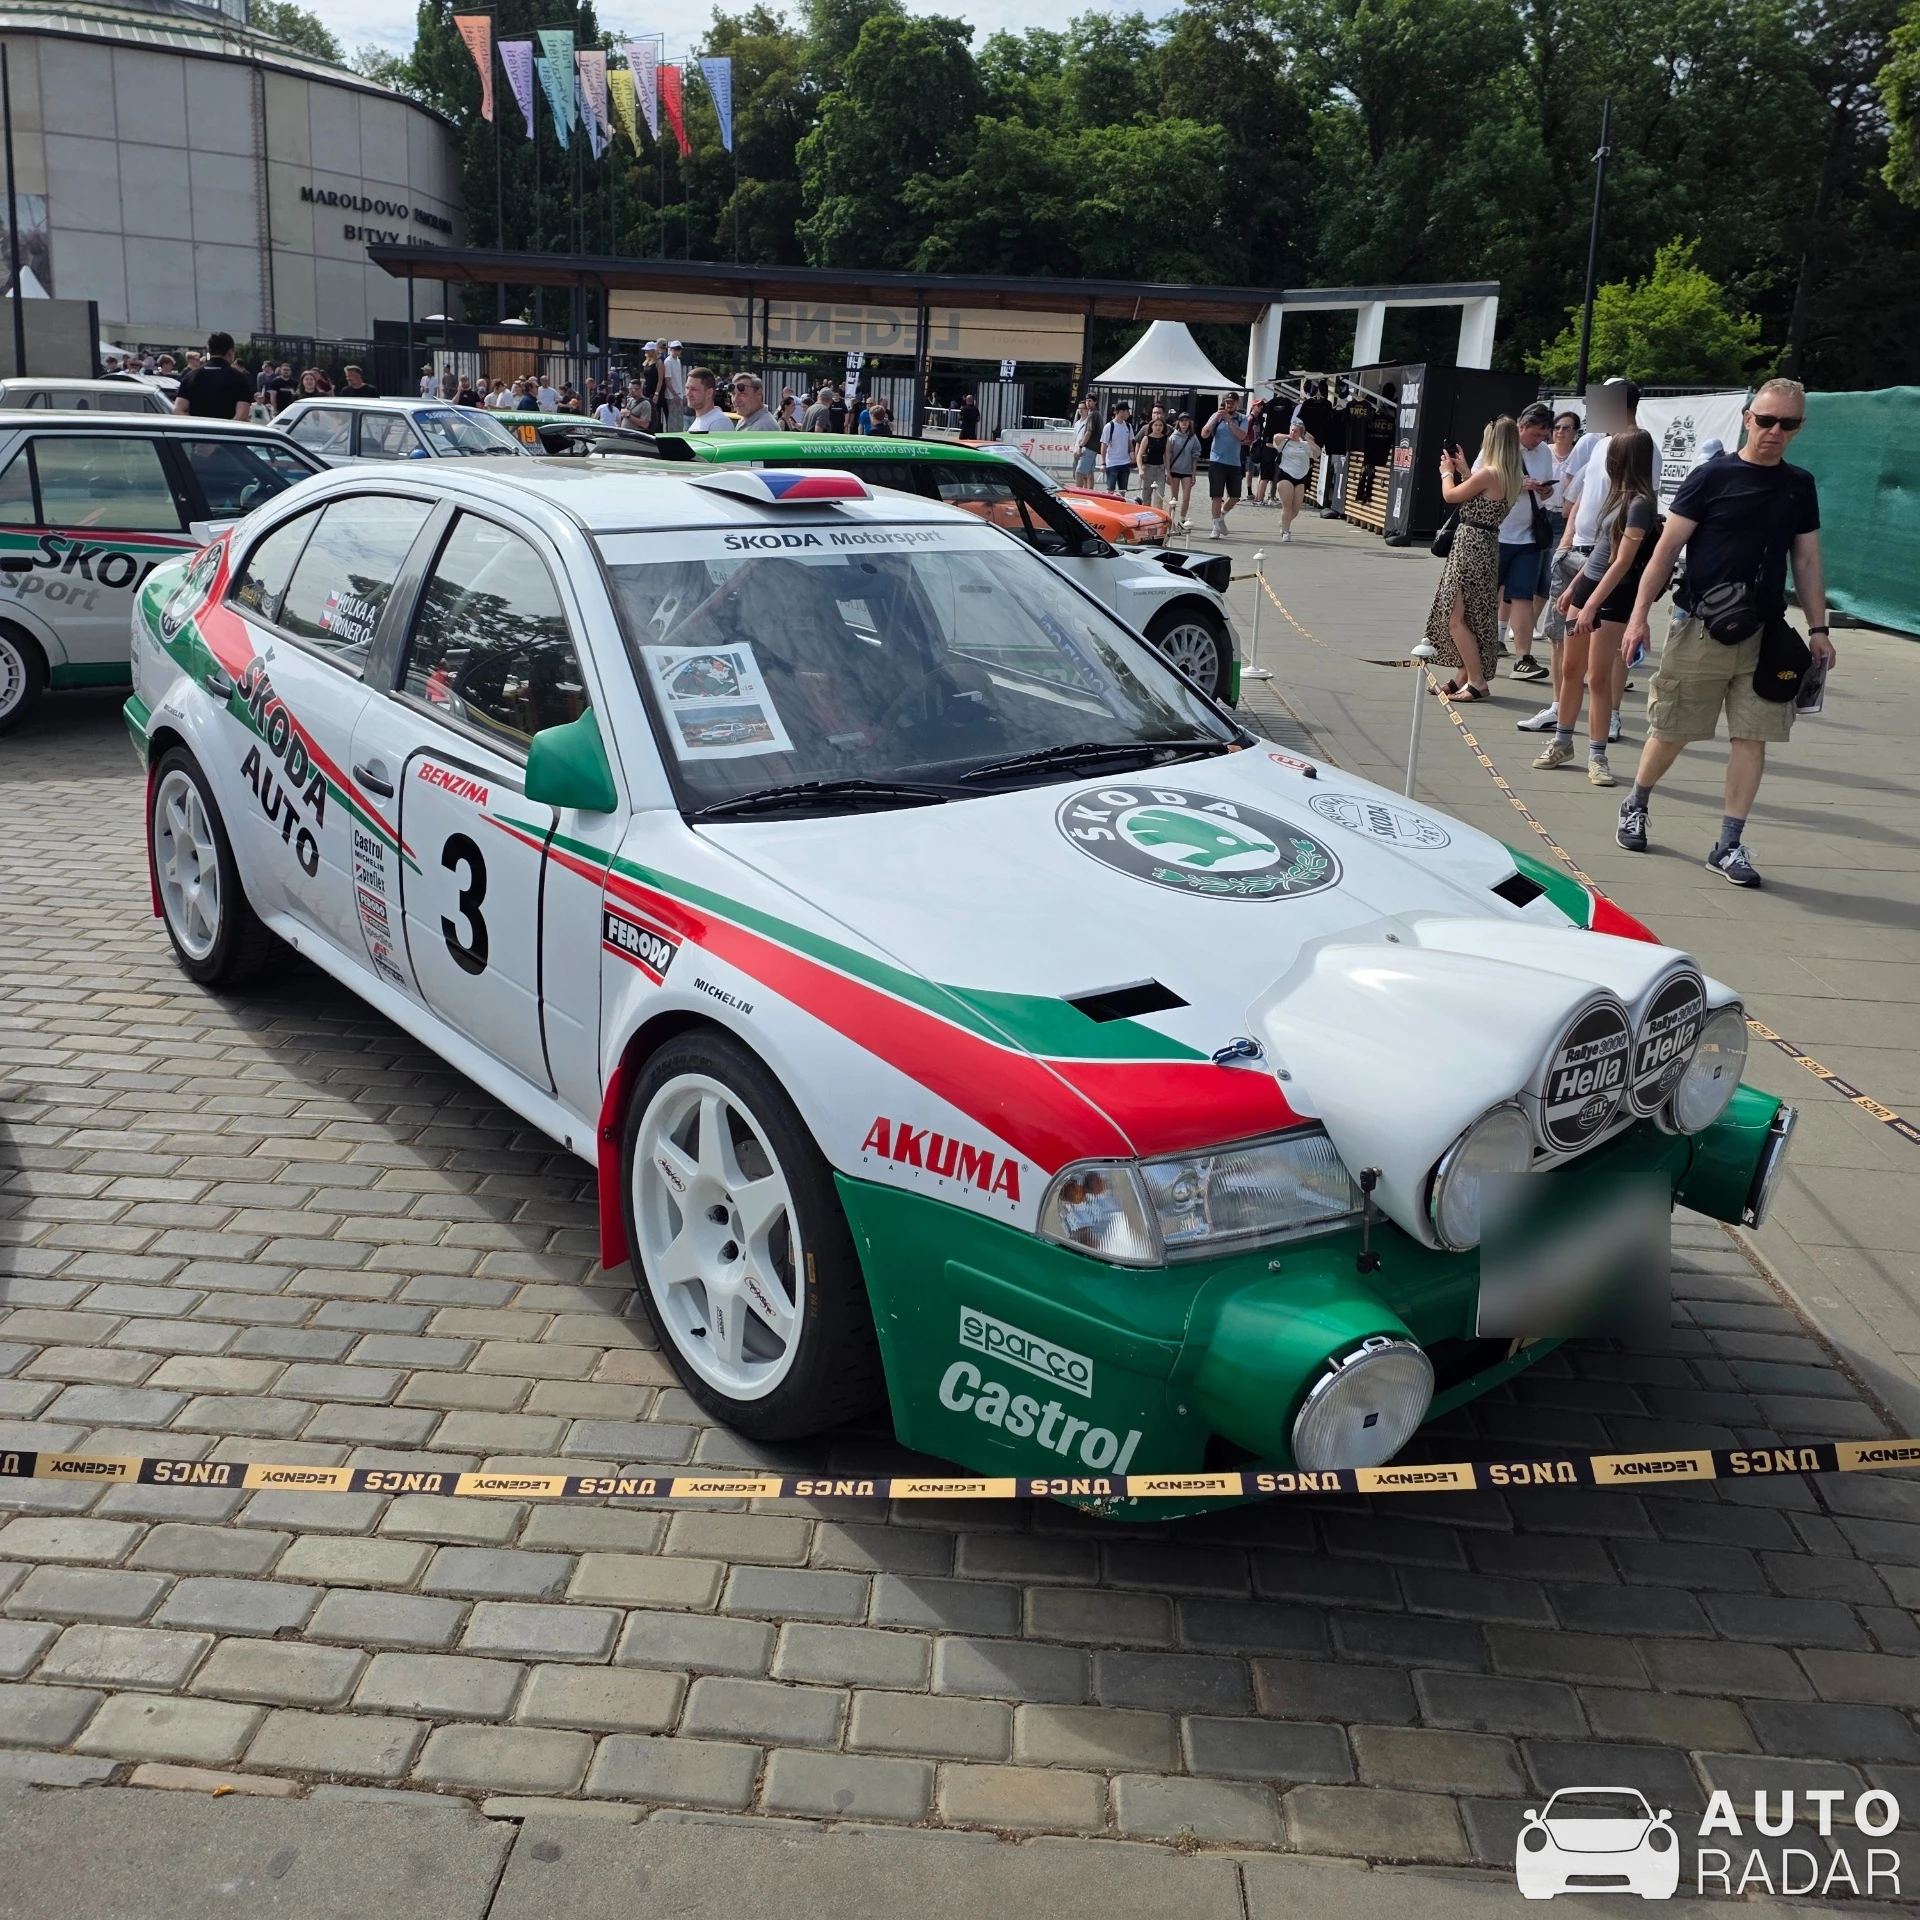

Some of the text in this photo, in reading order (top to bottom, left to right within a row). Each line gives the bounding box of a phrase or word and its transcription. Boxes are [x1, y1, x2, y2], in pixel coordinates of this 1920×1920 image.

[300, 186, 409, 220] MAROLDOVO
[344, 224, 400, 244] BITVY
[518, 425, 537, 443] 19
[800, 443, 931, 458] www.autopodborany.cz
[1662, 464, 1691, 478] EGENDY
[724, 528, 946, 552] ŠKODA Motorsport
[32, 530, 160, 593] ŠKO
[329, 614, 362, 643] TRINER
[163, 703, 186, 720] MICHELIN
[238, 645, 331, 831] ŠKODA
[417, 761, 490, 807] BENZINA
[240, 745, 321, 878] AUTO
[1069, 790, 1240, 842] ŠKODA
[1318, 797, 1359, 829] ORIGINAL
[1366, 804, 1397, 840] ŠKODA
[354, 829, 383, 861] Castrol
[1413, 818, 1441, 845] PARTS
[354, 849, 385, 873] MICHELIN
[362, 867, 386, 893] proflex
[360, 893, 386, 918] FERODO
[439, 832, 489, 976] 3
[608, 917, 671, 970] FERODO
[693, 977, 754, 1015] MICHELIN
[1648, 998, 1702, 1036] Rallye 3000
[1565, 1033, 1628, 1064] Rallye 3000
[1641, 1022, 1697, 1072] Hella
[1555, 1057, 1622, 1102] Hella
[860, 1116, 1021, 1203] AKUMA
[863, 1156, 1016, 1211] BATERIE
[938, 1360, 1143, 1475] Castrol
[154, 1461, 230, 1484] UNCS
[364, 1472, 442, 1492] UNCS
[578, 1478, 657, 1495] UNCS
[795, 1479, 874, 1496] UNCS
[1030, 1479, 1111, 1495] UNCS
[1256, 1473, 1341, 1492] UNCS
[1491, 1461, 1578, 1485] UNCS
[1731, 1448, 1821, 1475] UNCS
